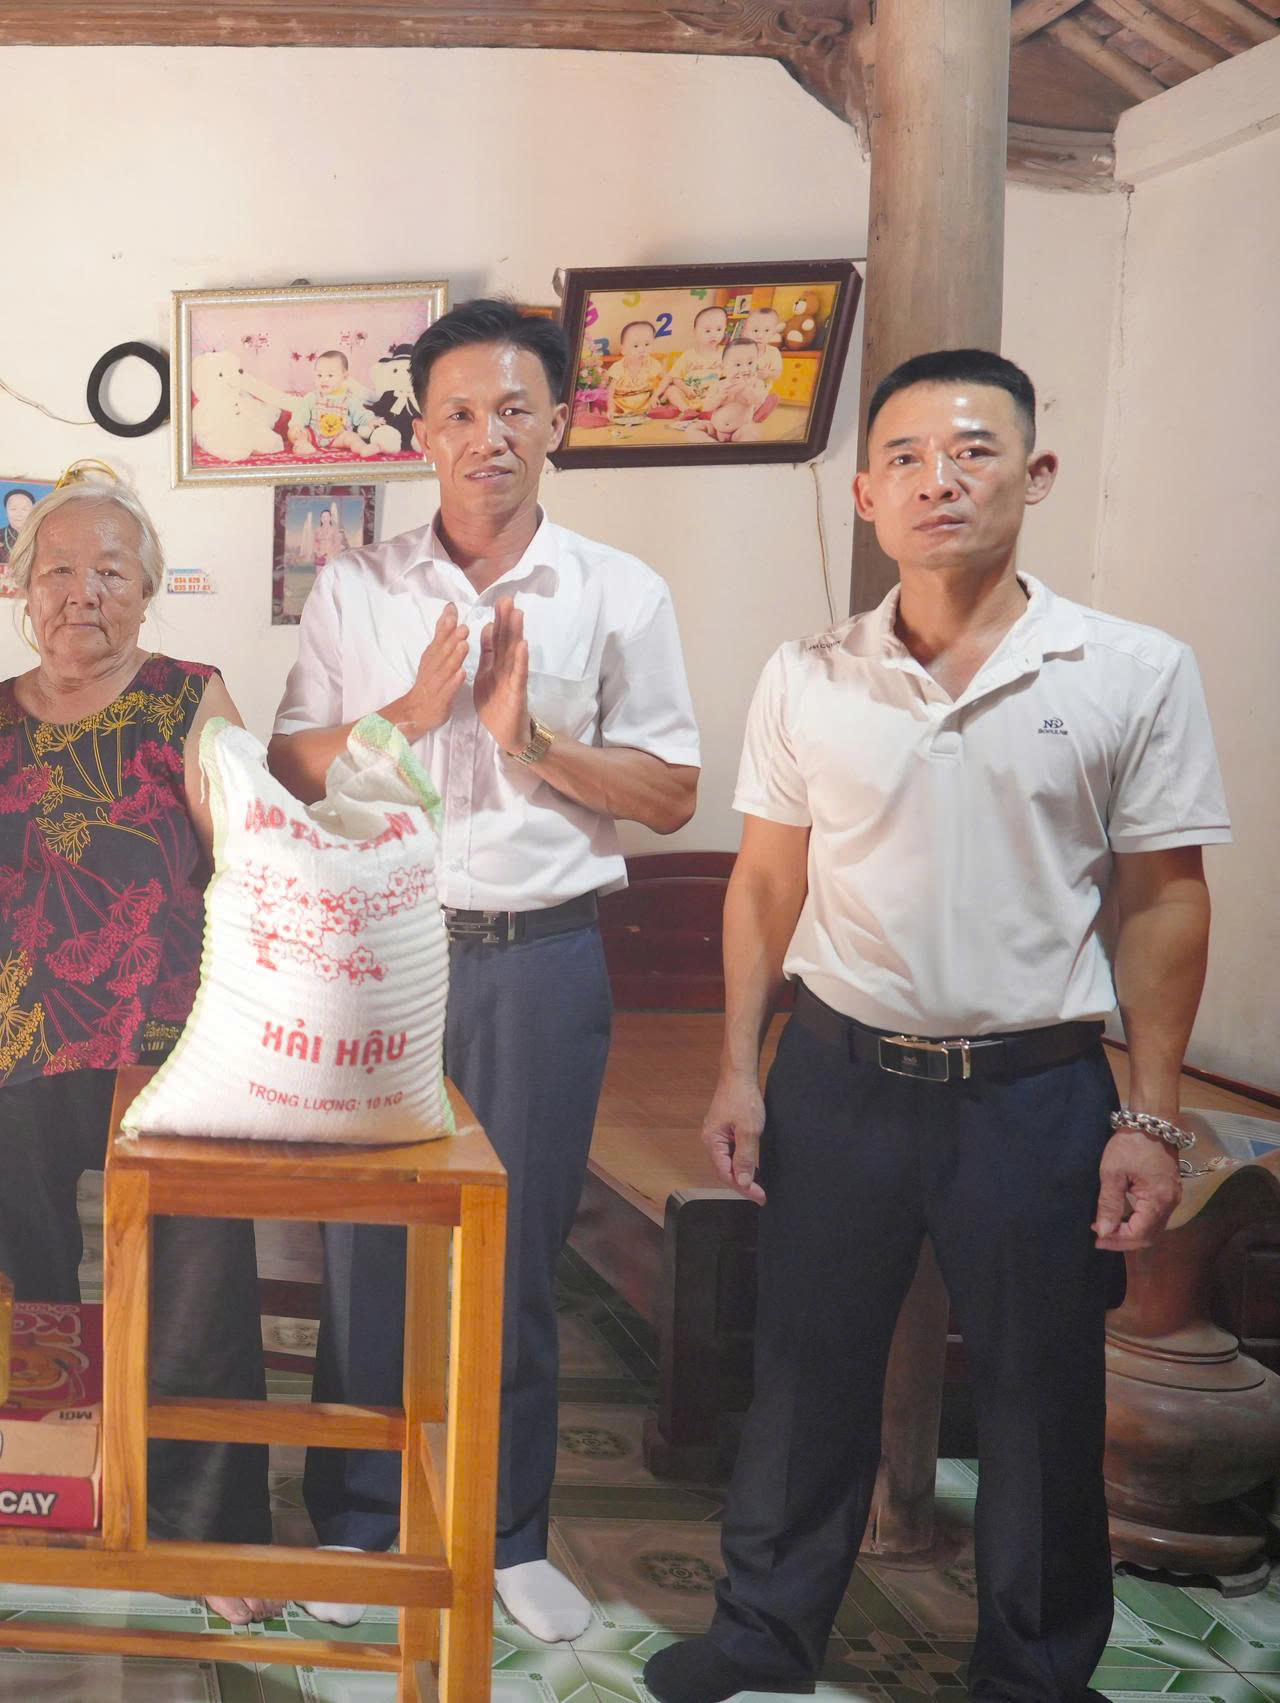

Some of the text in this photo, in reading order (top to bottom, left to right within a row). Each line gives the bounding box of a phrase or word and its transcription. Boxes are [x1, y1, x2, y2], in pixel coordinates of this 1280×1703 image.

[656, 313, 673, 337] 2
[261, 1018, 408, 1074] HẢI HẬU
[248, 1081, 300, 1107] TRỌNG
[367, 1097, 380, 1110] 10
[383, 1091, 404, 1108] KG
